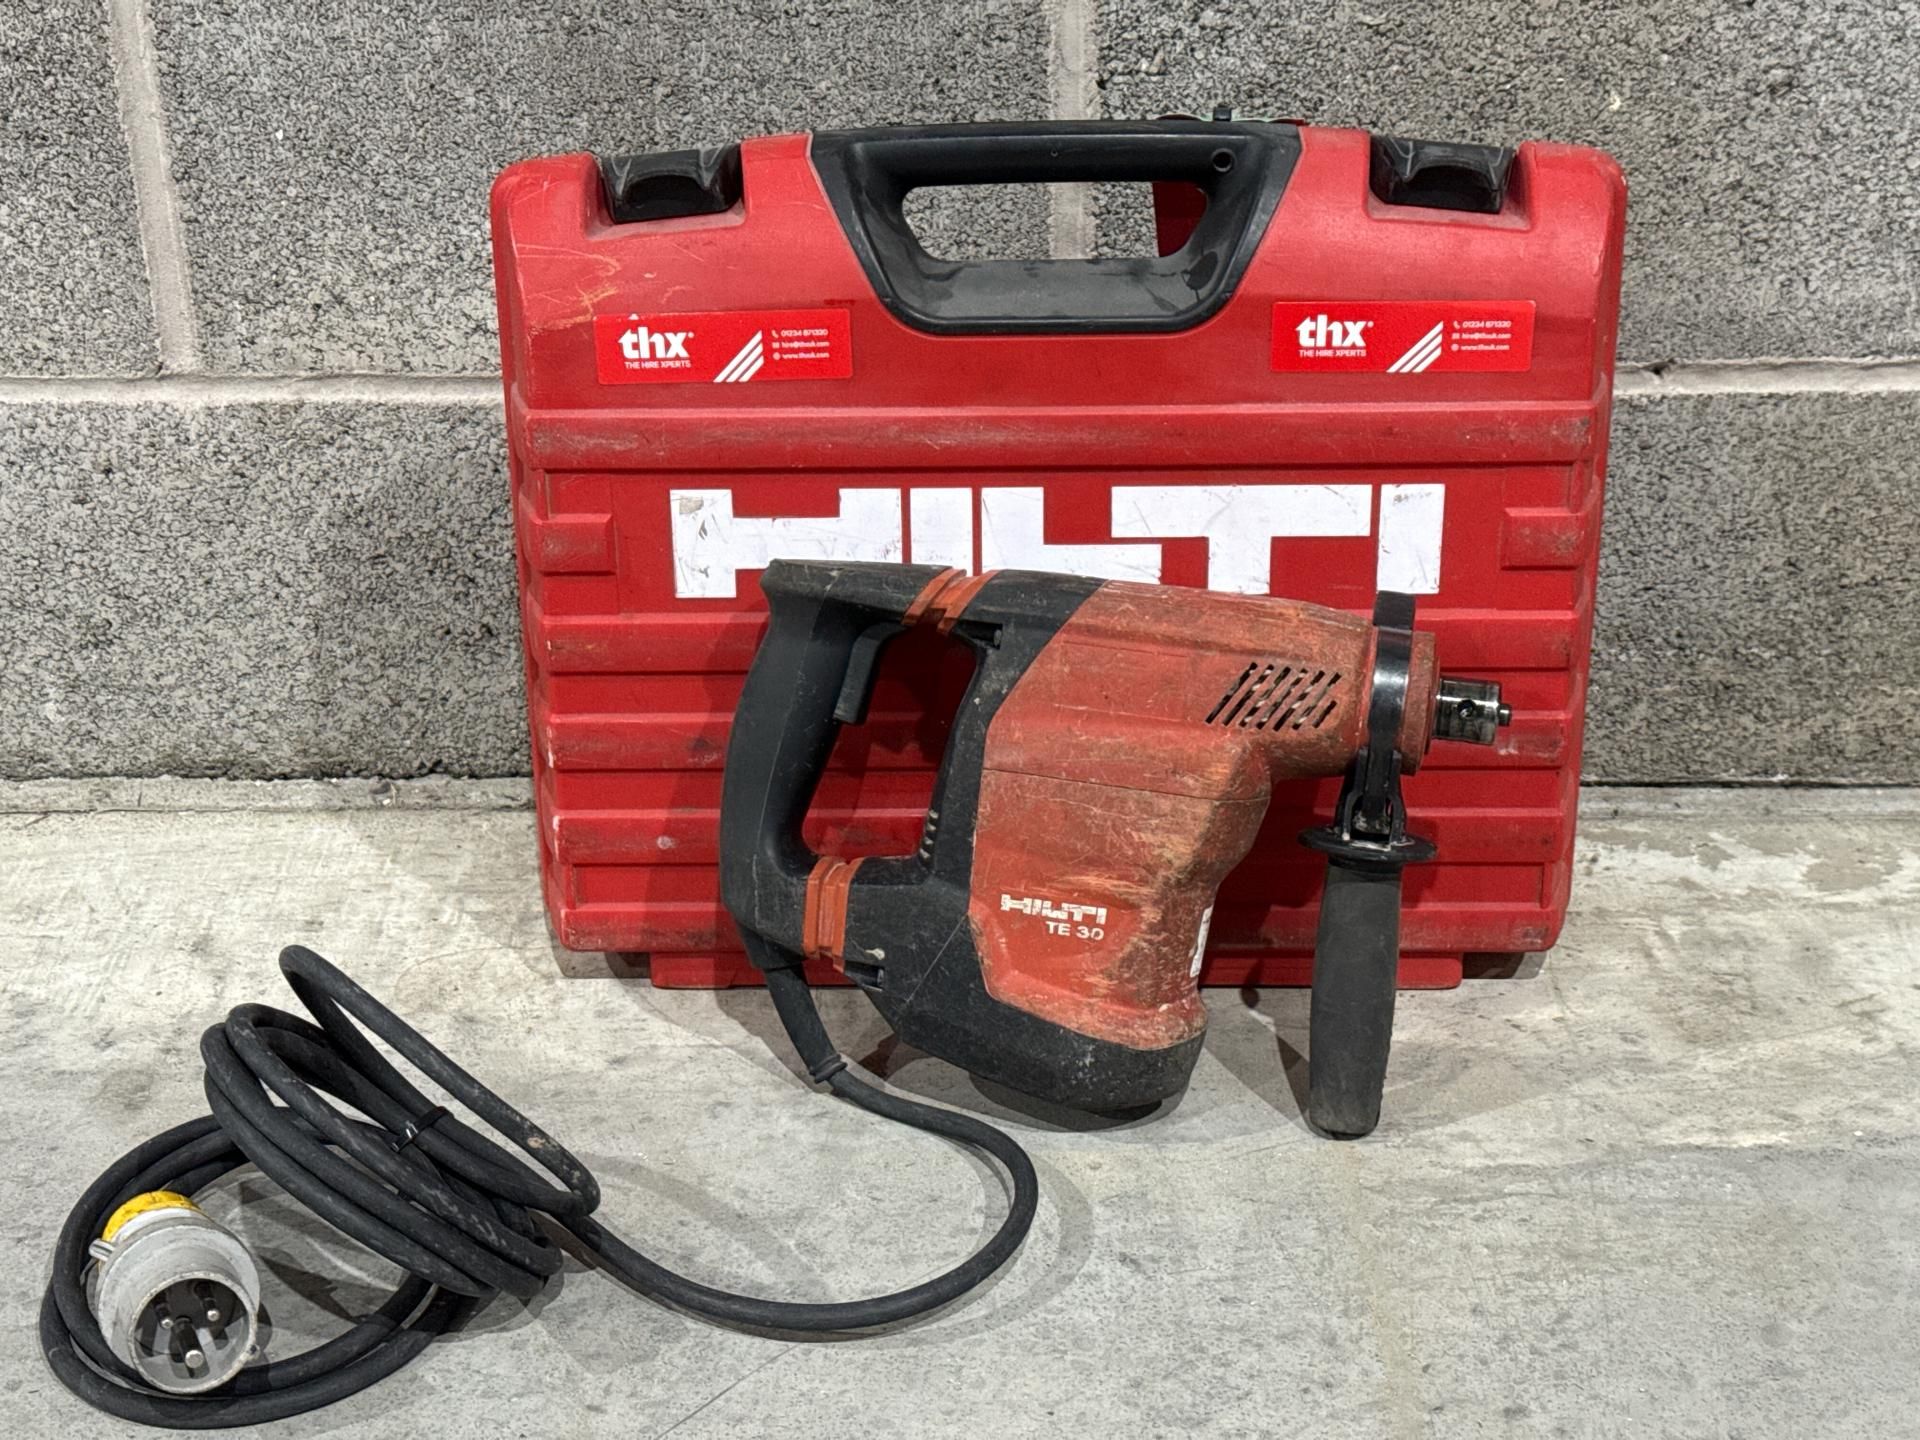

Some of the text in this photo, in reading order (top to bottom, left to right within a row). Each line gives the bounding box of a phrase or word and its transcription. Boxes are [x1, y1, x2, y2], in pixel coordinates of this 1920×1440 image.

[1299, 349, 1367, 357] THE HIRE XPERTS
[624, 361, 640, 369] THE
[661, 360, 691, 368] XPERTS
[670, 484, 1445, 599] HILTI
[1000, 893, 1108, 925] HILTI
[1045, 921, 1105, 941] TE 30
